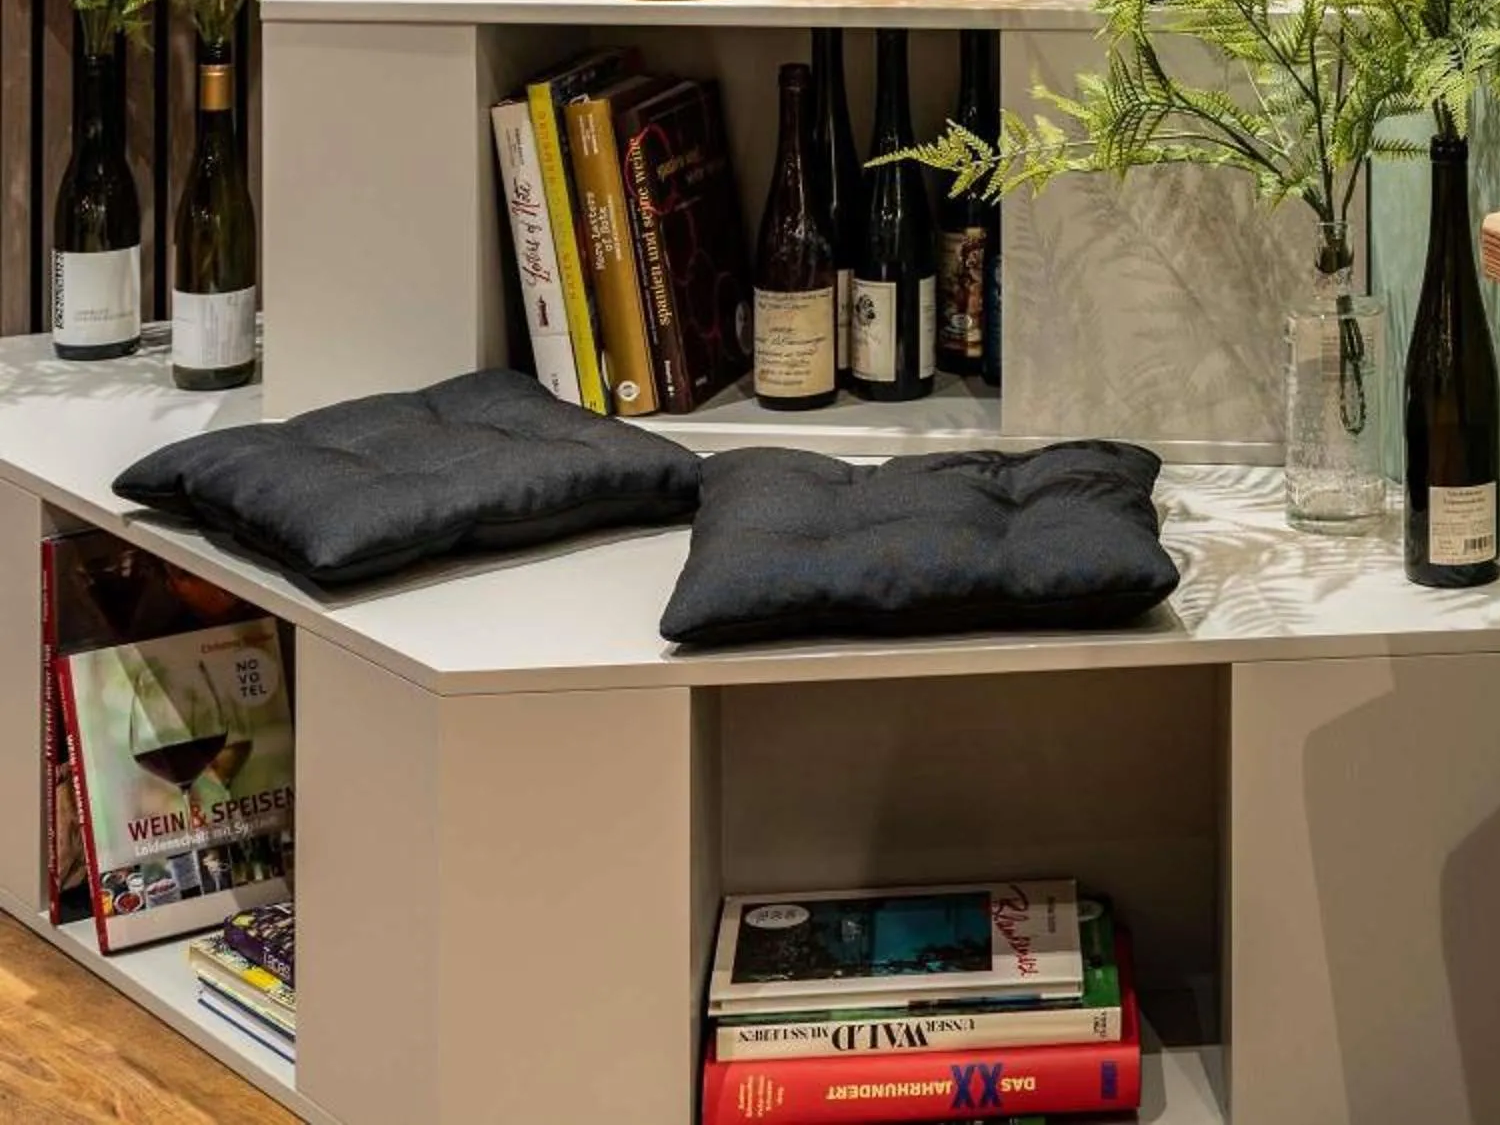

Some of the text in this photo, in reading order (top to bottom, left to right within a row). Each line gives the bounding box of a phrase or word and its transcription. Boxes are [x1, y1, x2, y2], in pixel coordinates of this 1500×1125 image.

[643, 231, 661, 262] und
[236, 658, 258, 672] NO
[239, 672, 260, 684] VO
[240, 685, 267, 697] TEL
[128, 786, 295, 841] WEIN & SPEISEN
[831, 1021, 929, 1052] WALD
[926, 1018, 976, 1033] UNSER
[826, 1063, 1036, 1109] DAS XX JAHRHUNDERT
